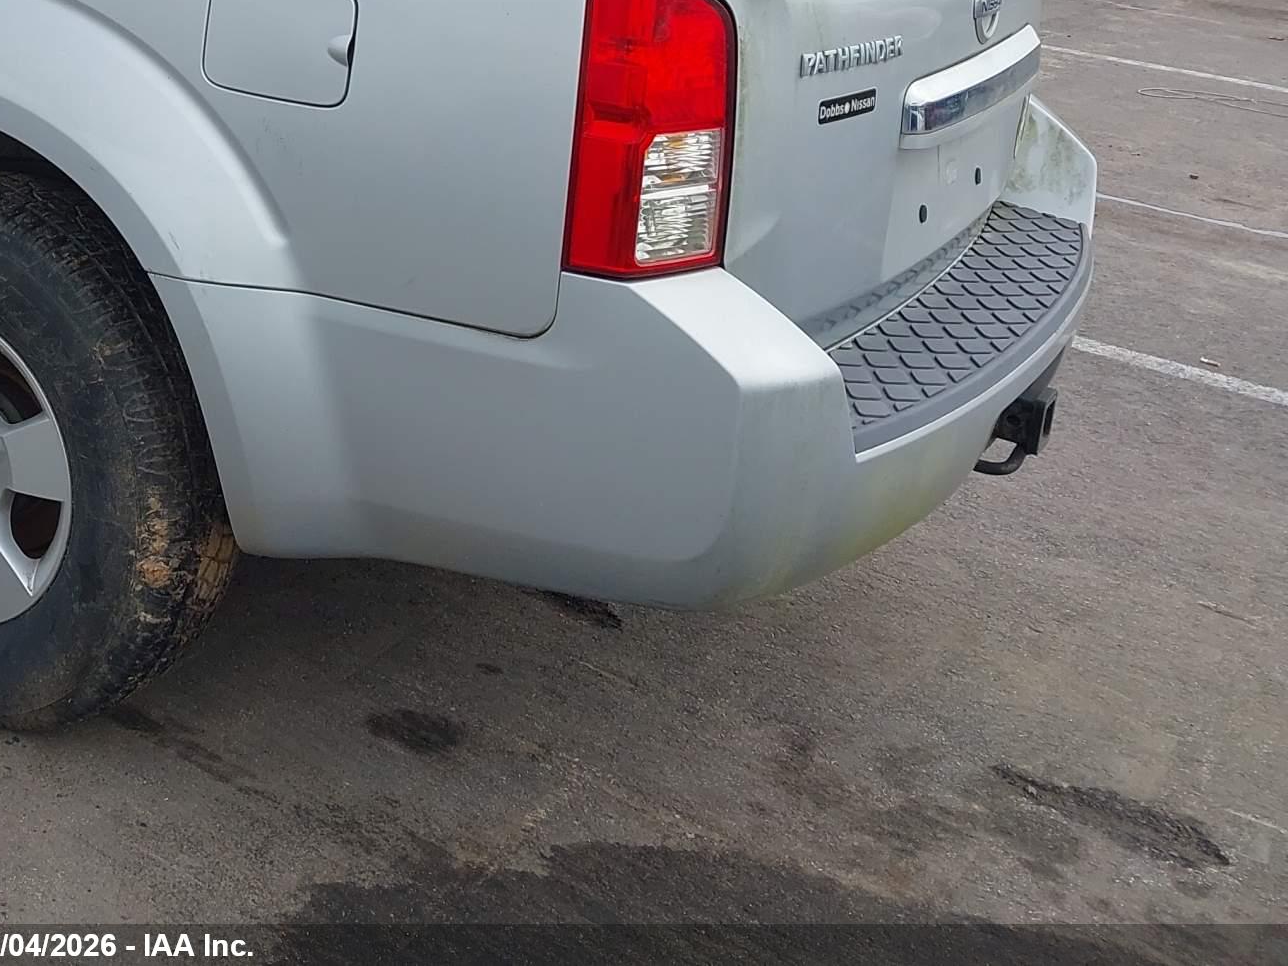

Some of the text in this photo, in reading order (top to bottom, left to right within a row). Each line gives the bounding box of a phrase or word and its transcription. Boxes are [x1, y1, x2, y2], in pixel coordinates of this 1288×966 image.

[800, 35, 903, 78] PATHFINDER
[819, 96, 876, 120] Dobbs Nissan
